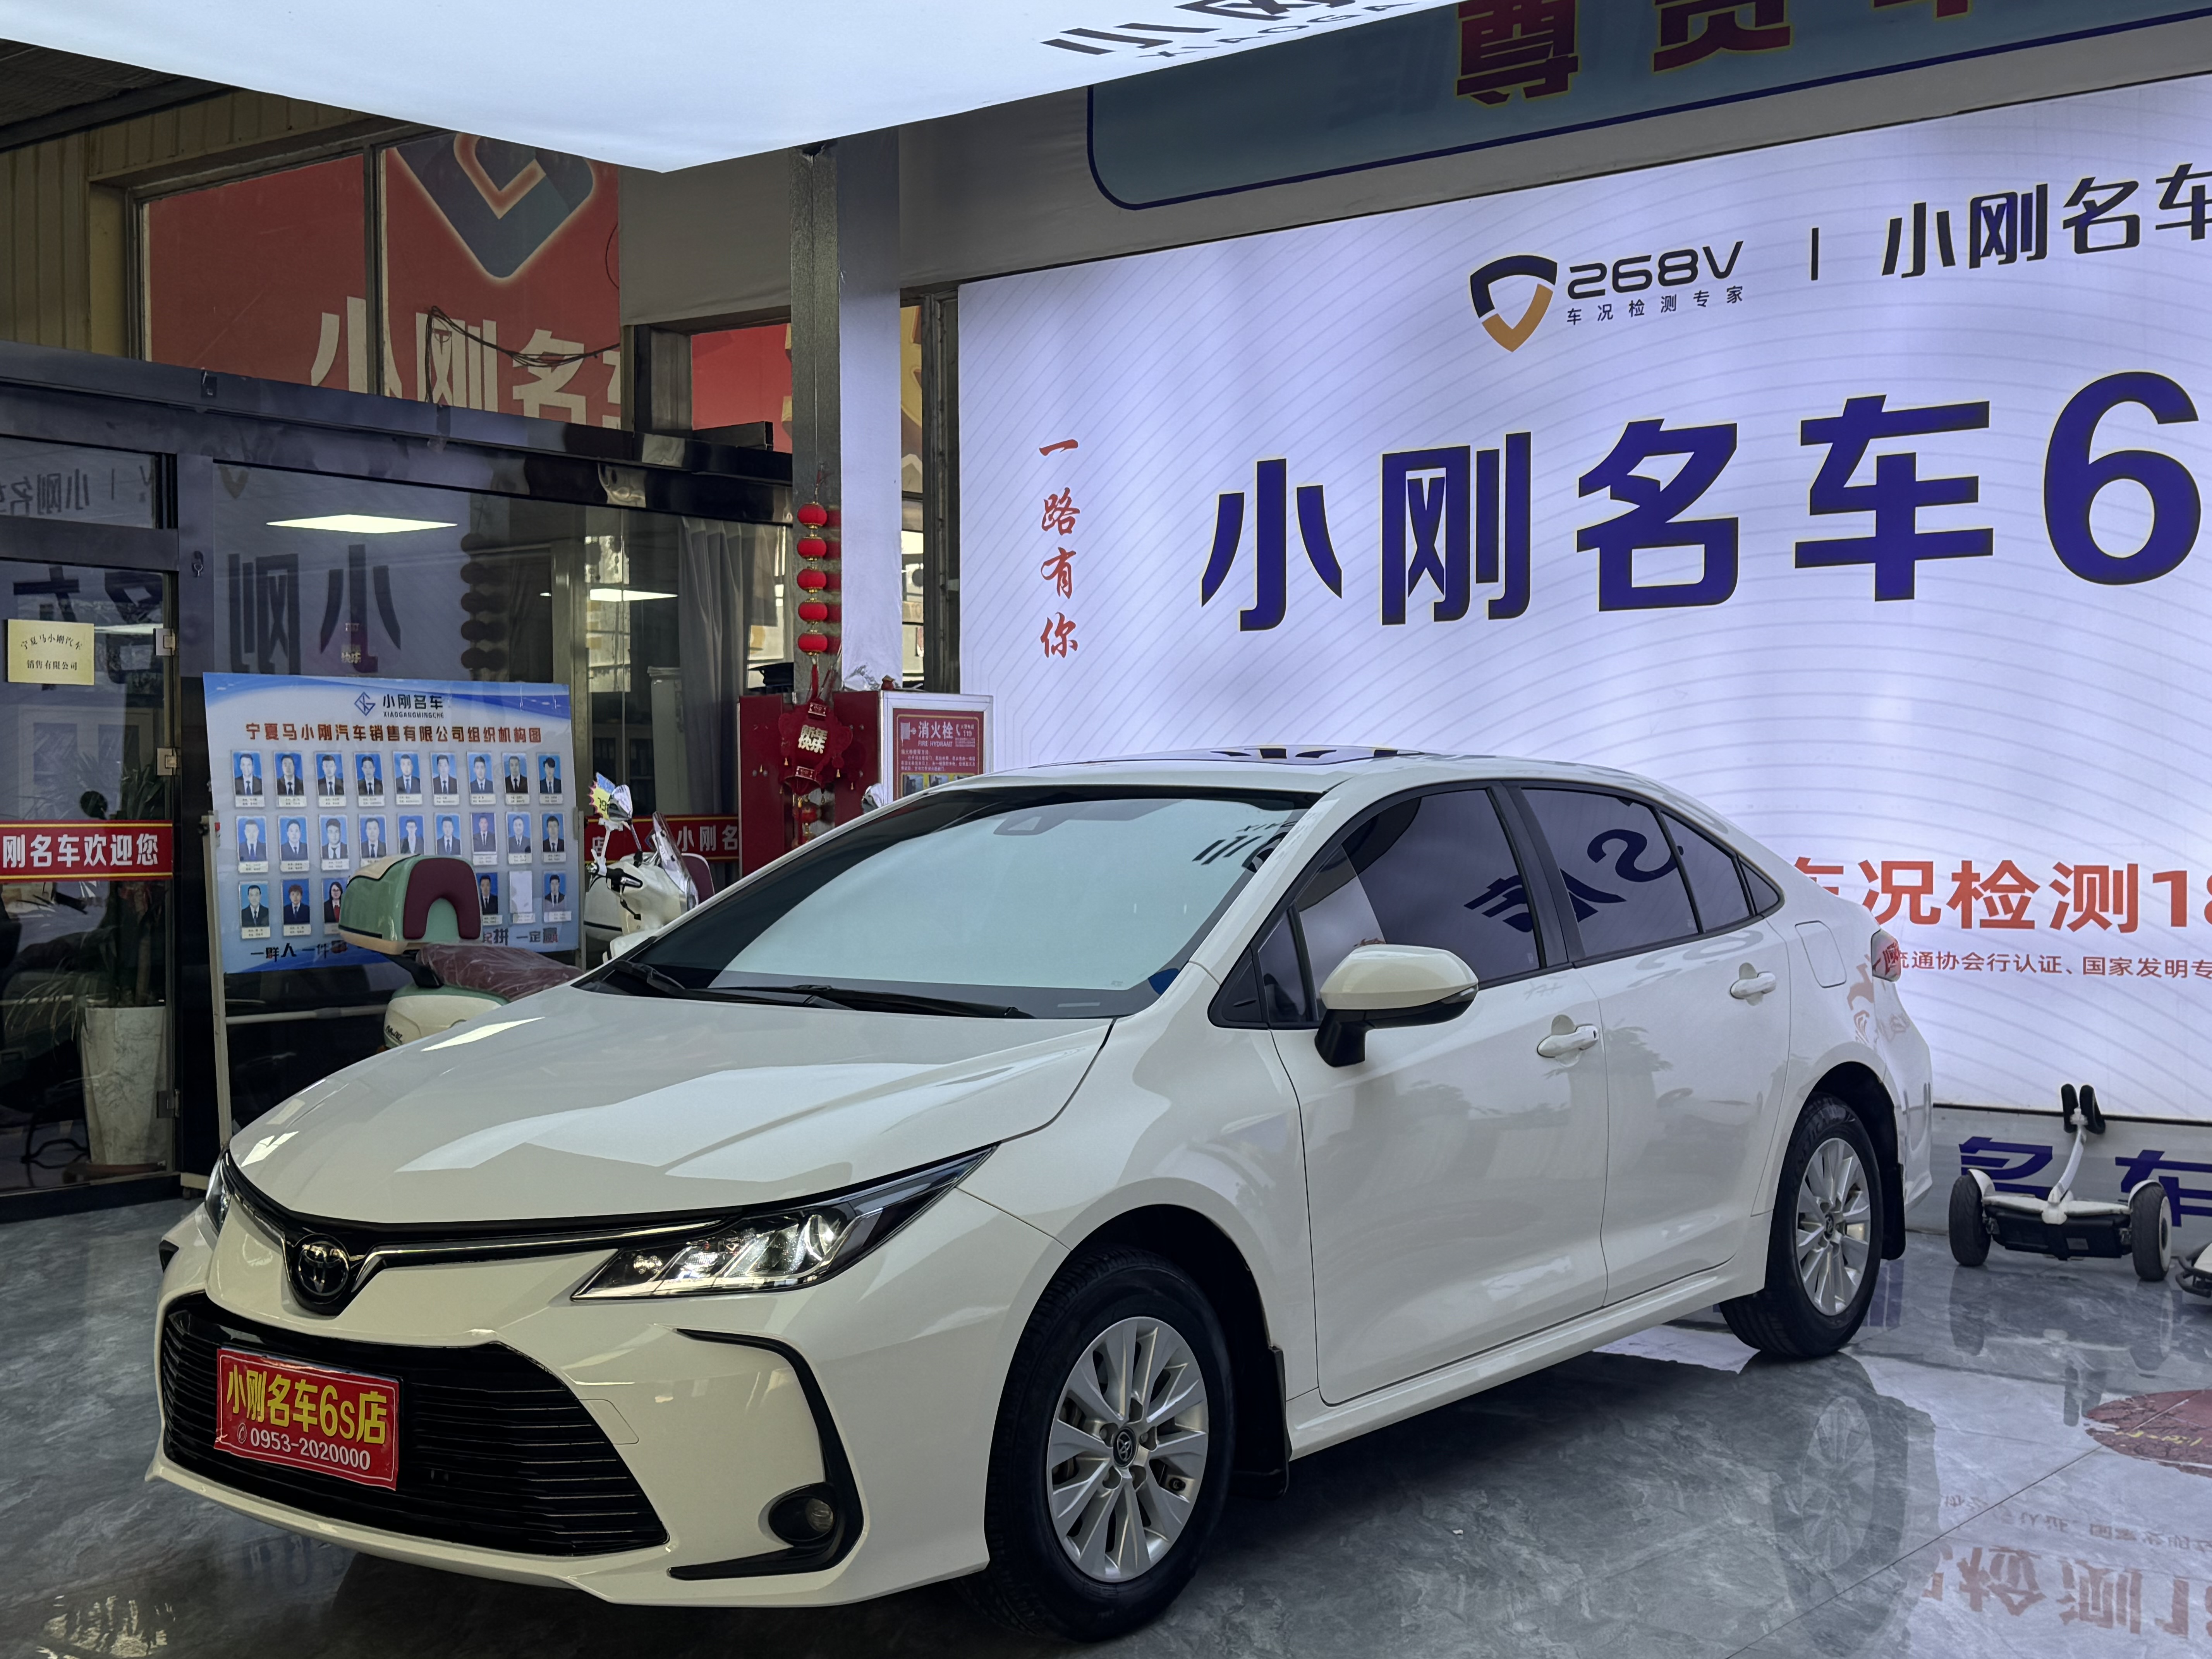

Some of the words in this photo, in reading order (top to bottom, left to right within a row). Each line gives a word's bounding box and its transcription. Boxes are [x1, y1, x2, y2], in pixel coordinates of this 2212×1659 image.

[1881, 163, 2212, 278] 小刚名车
[1568, 240, 1743, 300] 268V
[1567, 285, 1743, 325] 车况检测专家
[1039, 439, 1080, 658] 一路有你
[27, 659, 77, 671] 销售有限公司
[383, 694, 443, 710] 小刚名车
[246, 723, 541, 743] 宁夏马小刚汽车销售有限公司组织机构图
[918, 720, 953, 739] 消火栓
[3, 834, 158, 868] 刚名车欢迎您
[677, 824, 738, 852] 小刚名
[250, 1427, 371, 1470] 0953-2020000
